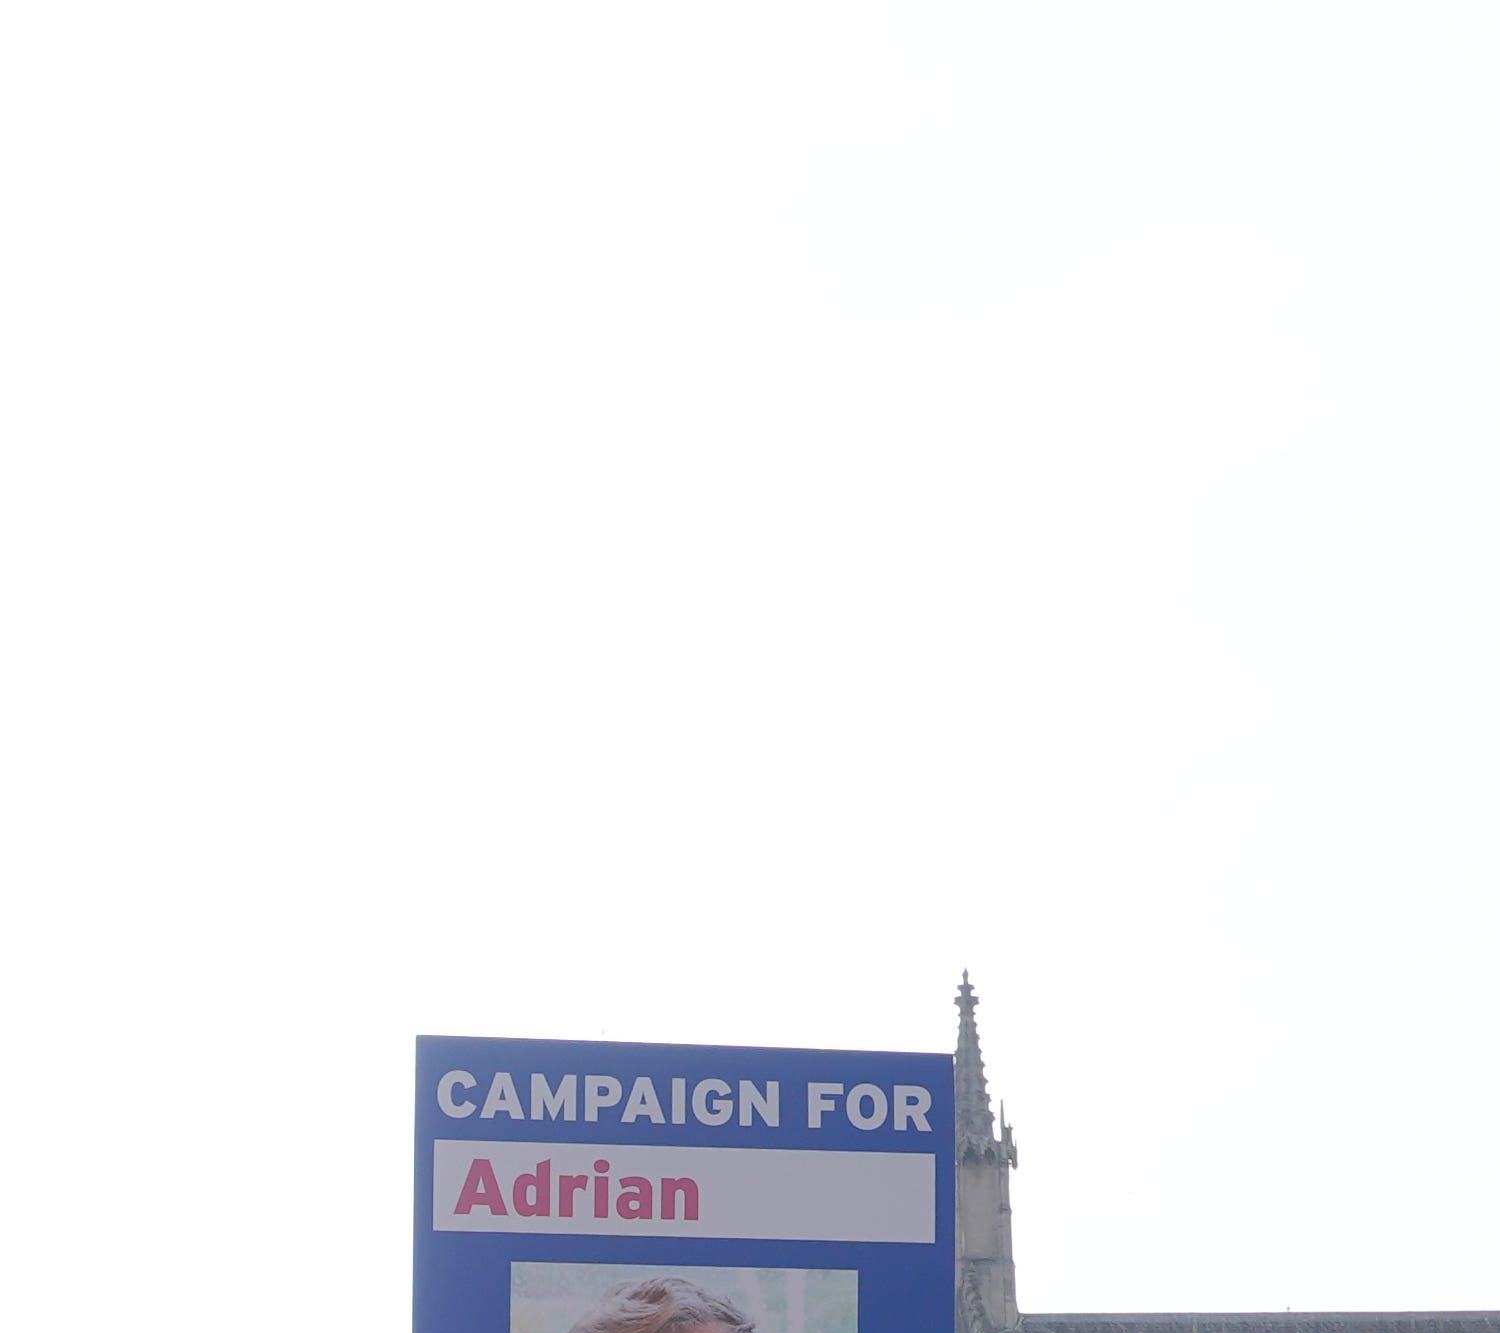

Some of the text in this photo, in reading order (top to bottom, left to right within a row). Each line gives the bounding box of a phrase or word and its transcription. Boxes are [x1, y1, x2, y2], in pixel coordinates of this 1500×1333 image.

[437, 1070, 932, 1131] CAMPAIGN FOR
[454, 1159, 699, 1220] Adrian
